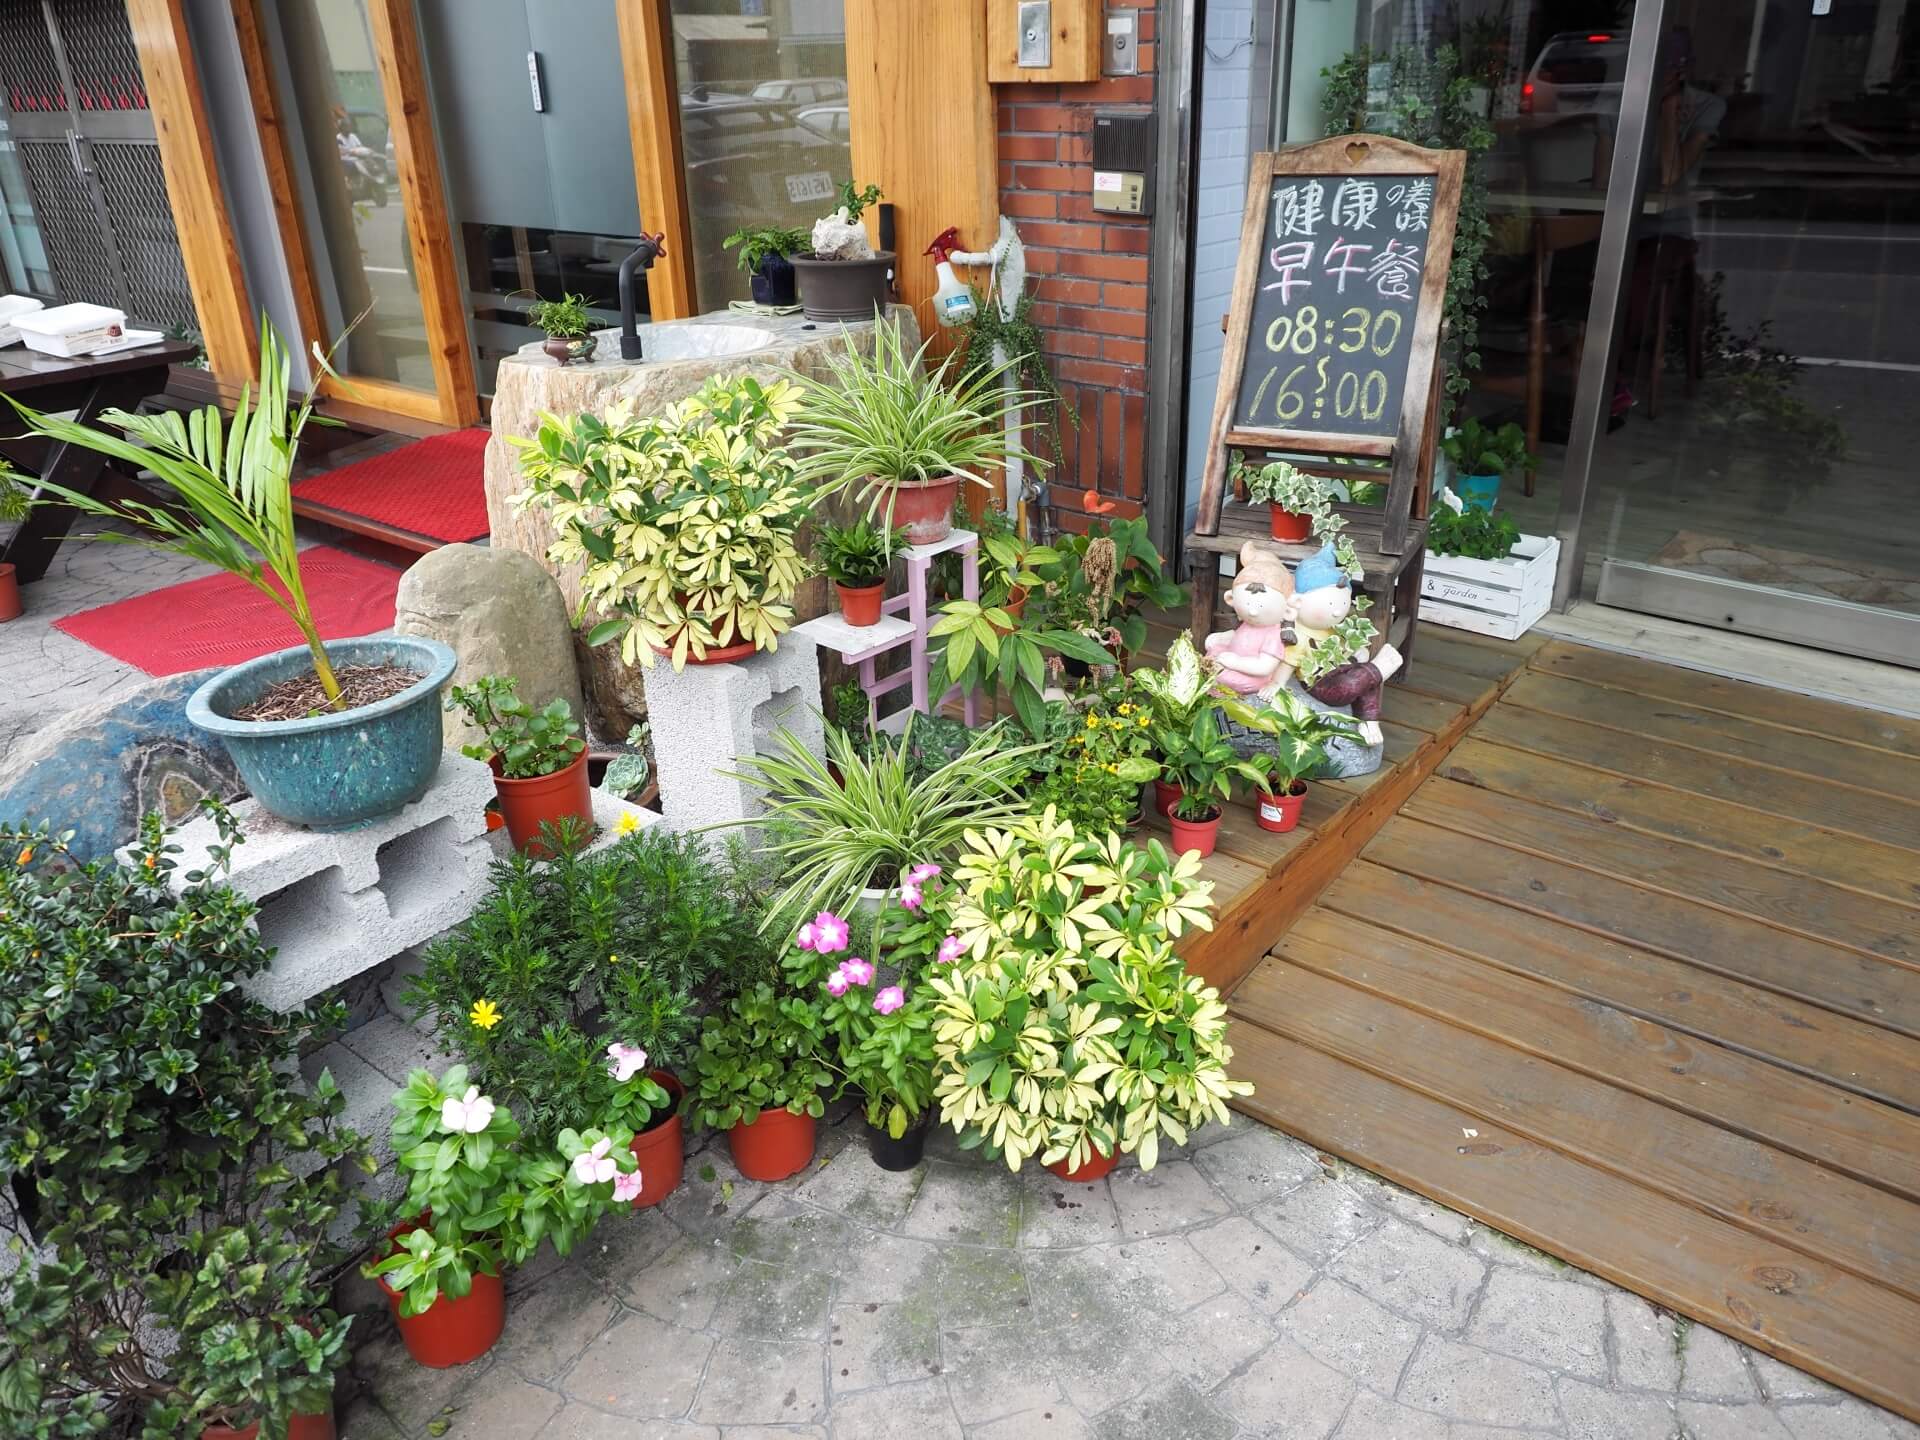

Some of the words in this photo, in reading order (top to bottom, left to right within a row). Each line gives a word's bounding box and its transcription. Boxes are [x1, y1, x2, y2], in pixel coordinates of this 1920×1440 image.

[1263, 237, 1420, 305] 早午餐
[1265, 306, 1401, 356] 08:30
[1250, 365, 1387, 419] 16:00
[1427, 579, 1435, 591] &
